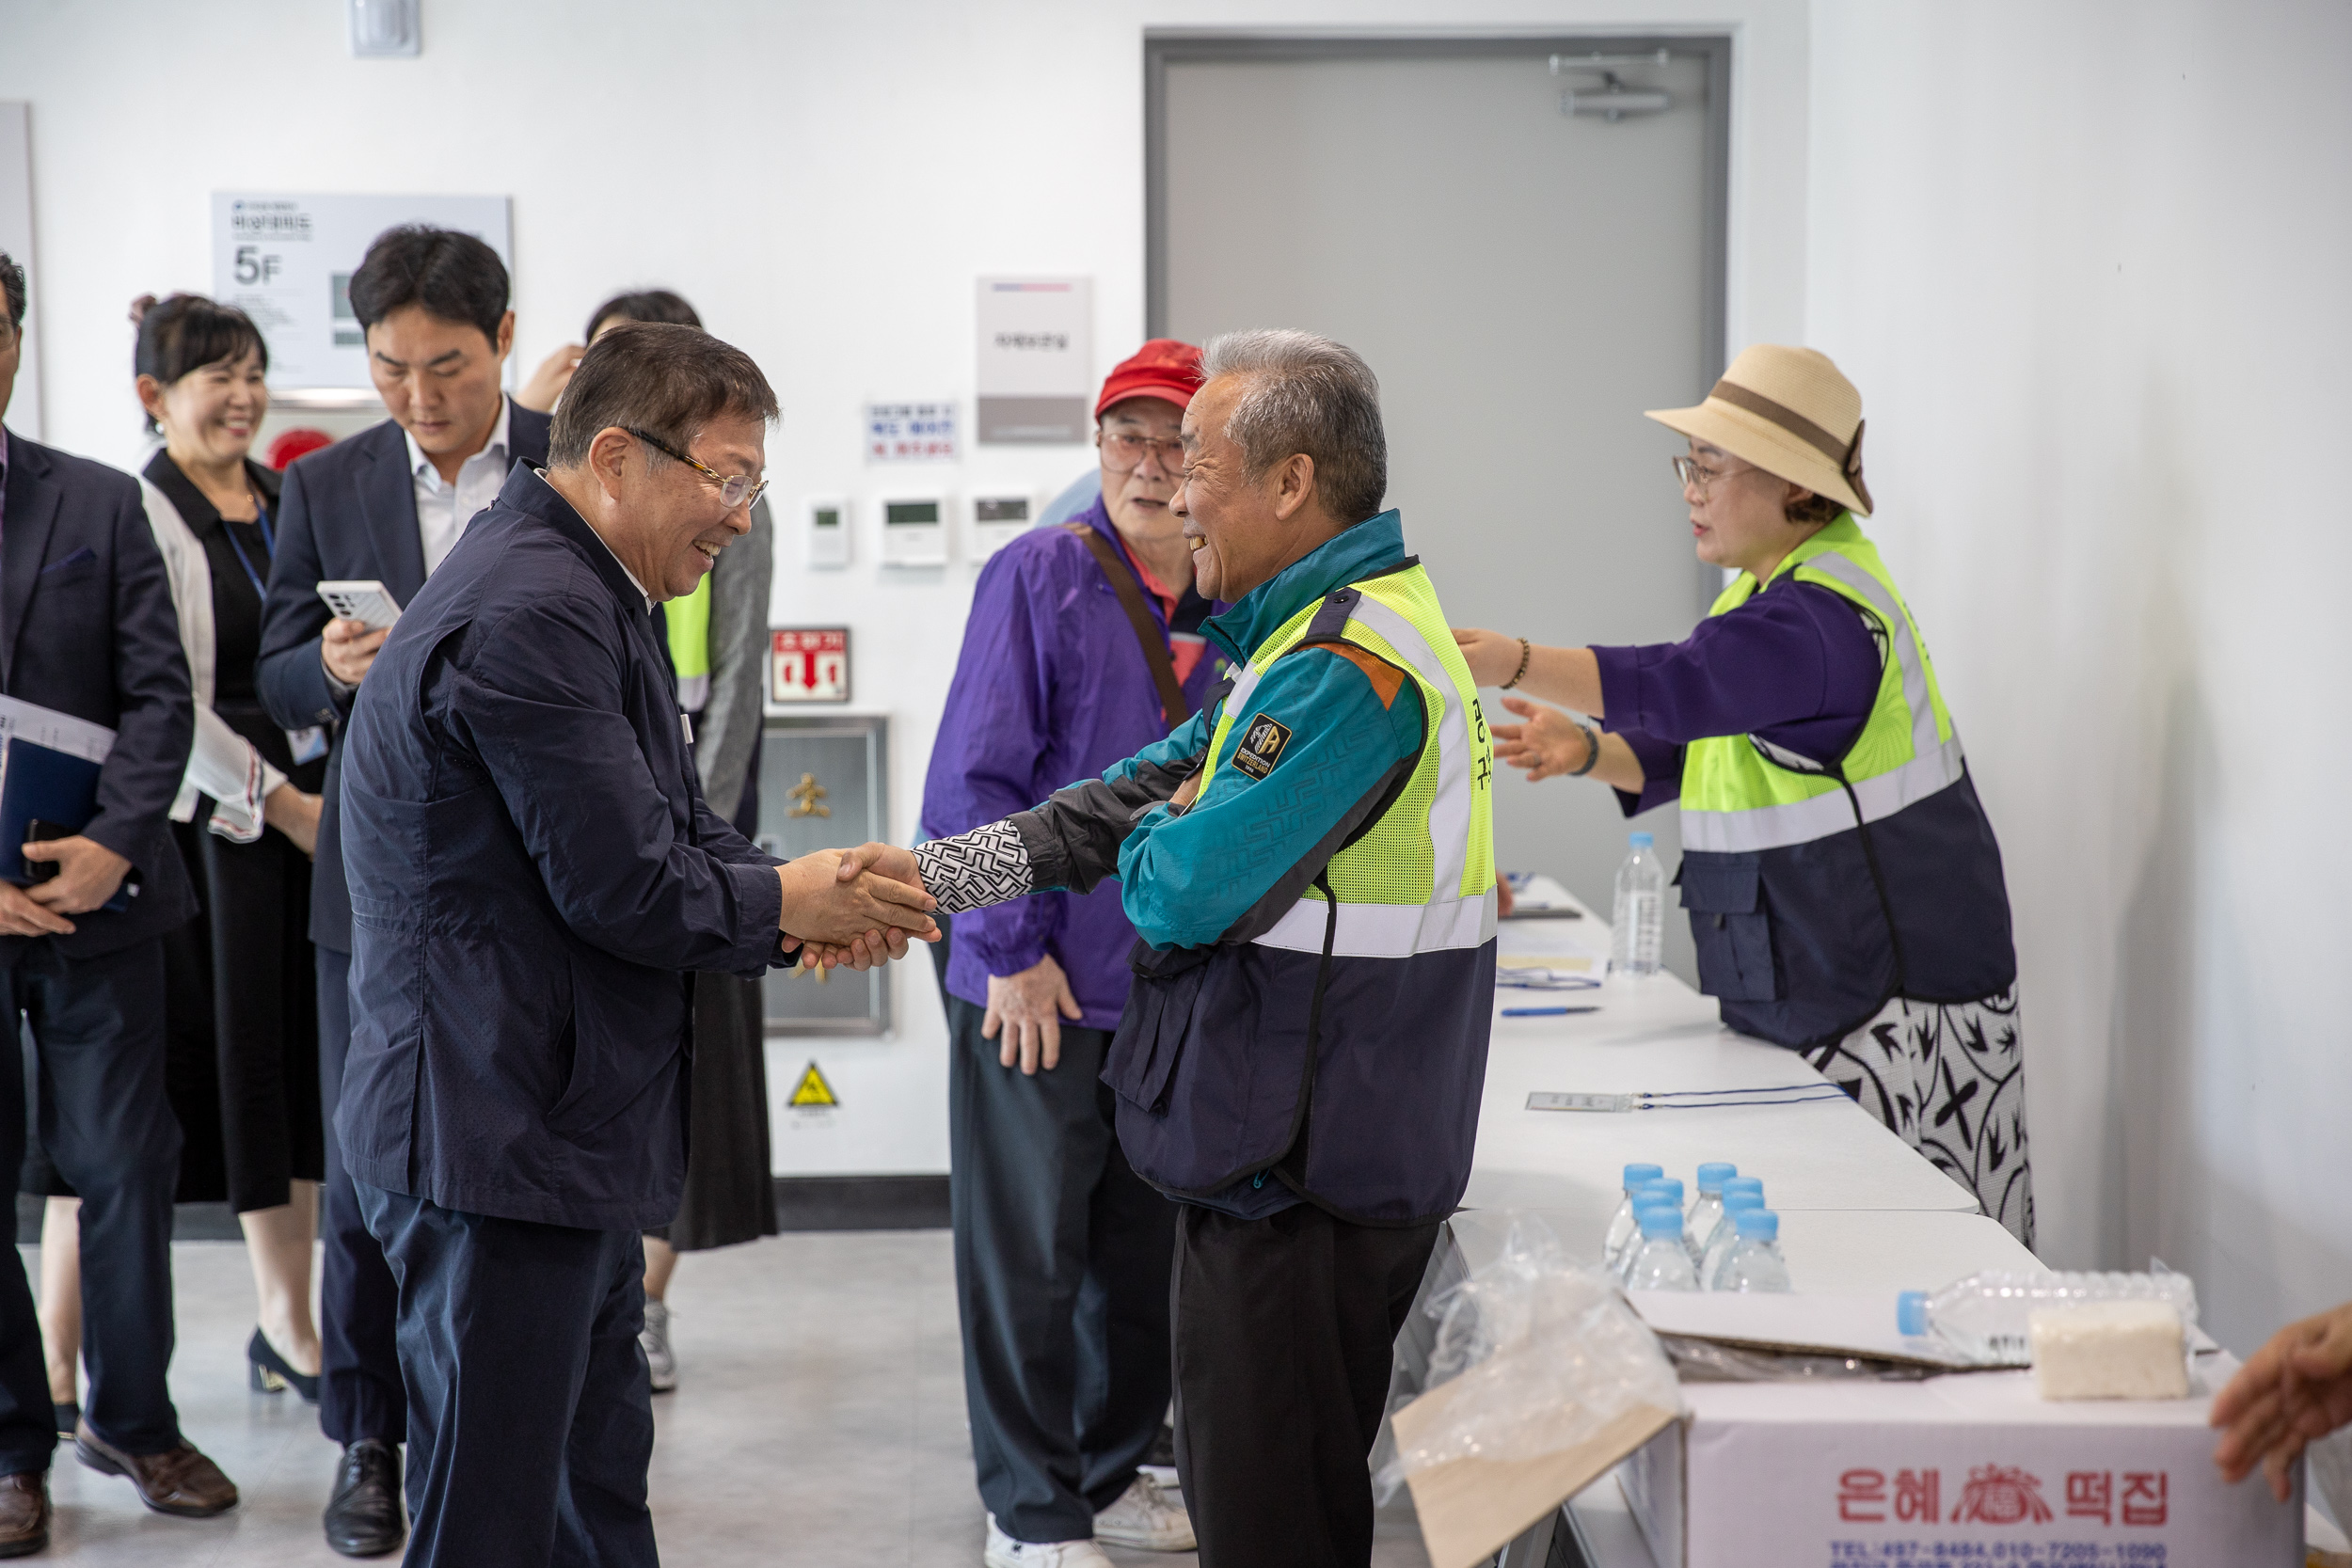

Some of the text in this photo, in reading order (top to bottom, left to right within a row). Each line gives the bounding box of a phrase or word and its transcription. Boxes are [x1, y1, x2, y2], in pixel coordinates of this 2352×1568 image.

[233, 245, 283, 285] 5F
[1237, 752, 1269, 774] SWITZERLAND
[1240, 747, 1271, 768] EXPEDITION
[1837, 1467, 2169, 1527] 은혜 떡집
